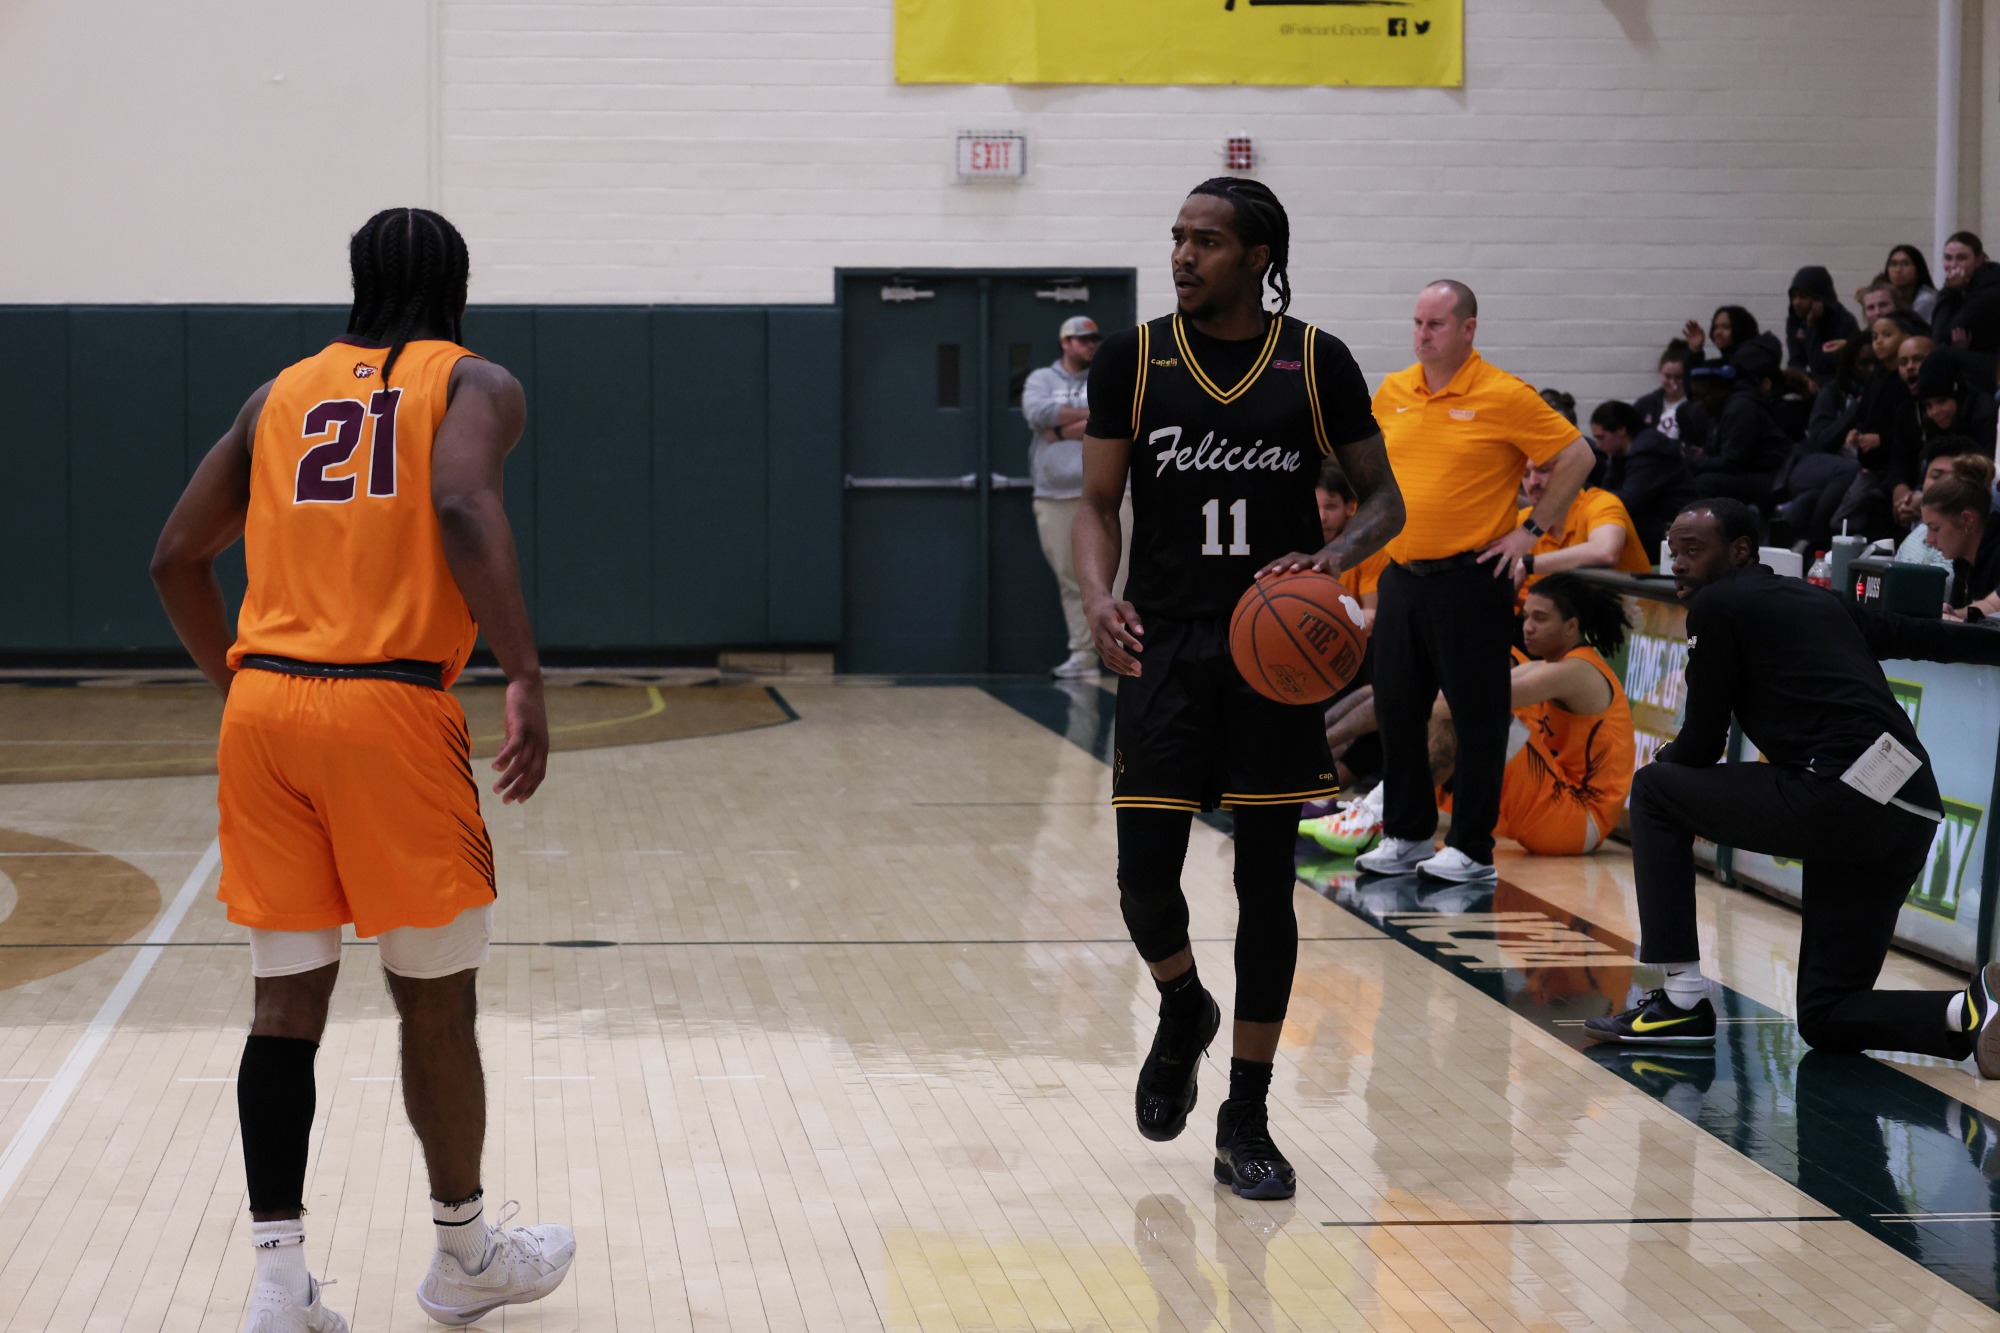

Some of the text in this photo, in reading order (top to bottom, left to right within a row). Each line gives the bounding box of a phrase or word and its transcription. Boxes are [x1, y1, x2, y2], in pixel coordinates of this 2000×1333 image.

[971, 142, 1012, 169] EXIT
[293, 387, 404, 505] 21
[1149, 425, 1301, 478] Felician
[1202, 498, 1250, 556] 11
[1297, 612, 1339, 655] THE
[1624, 634, 1688, 709] HOME OF
